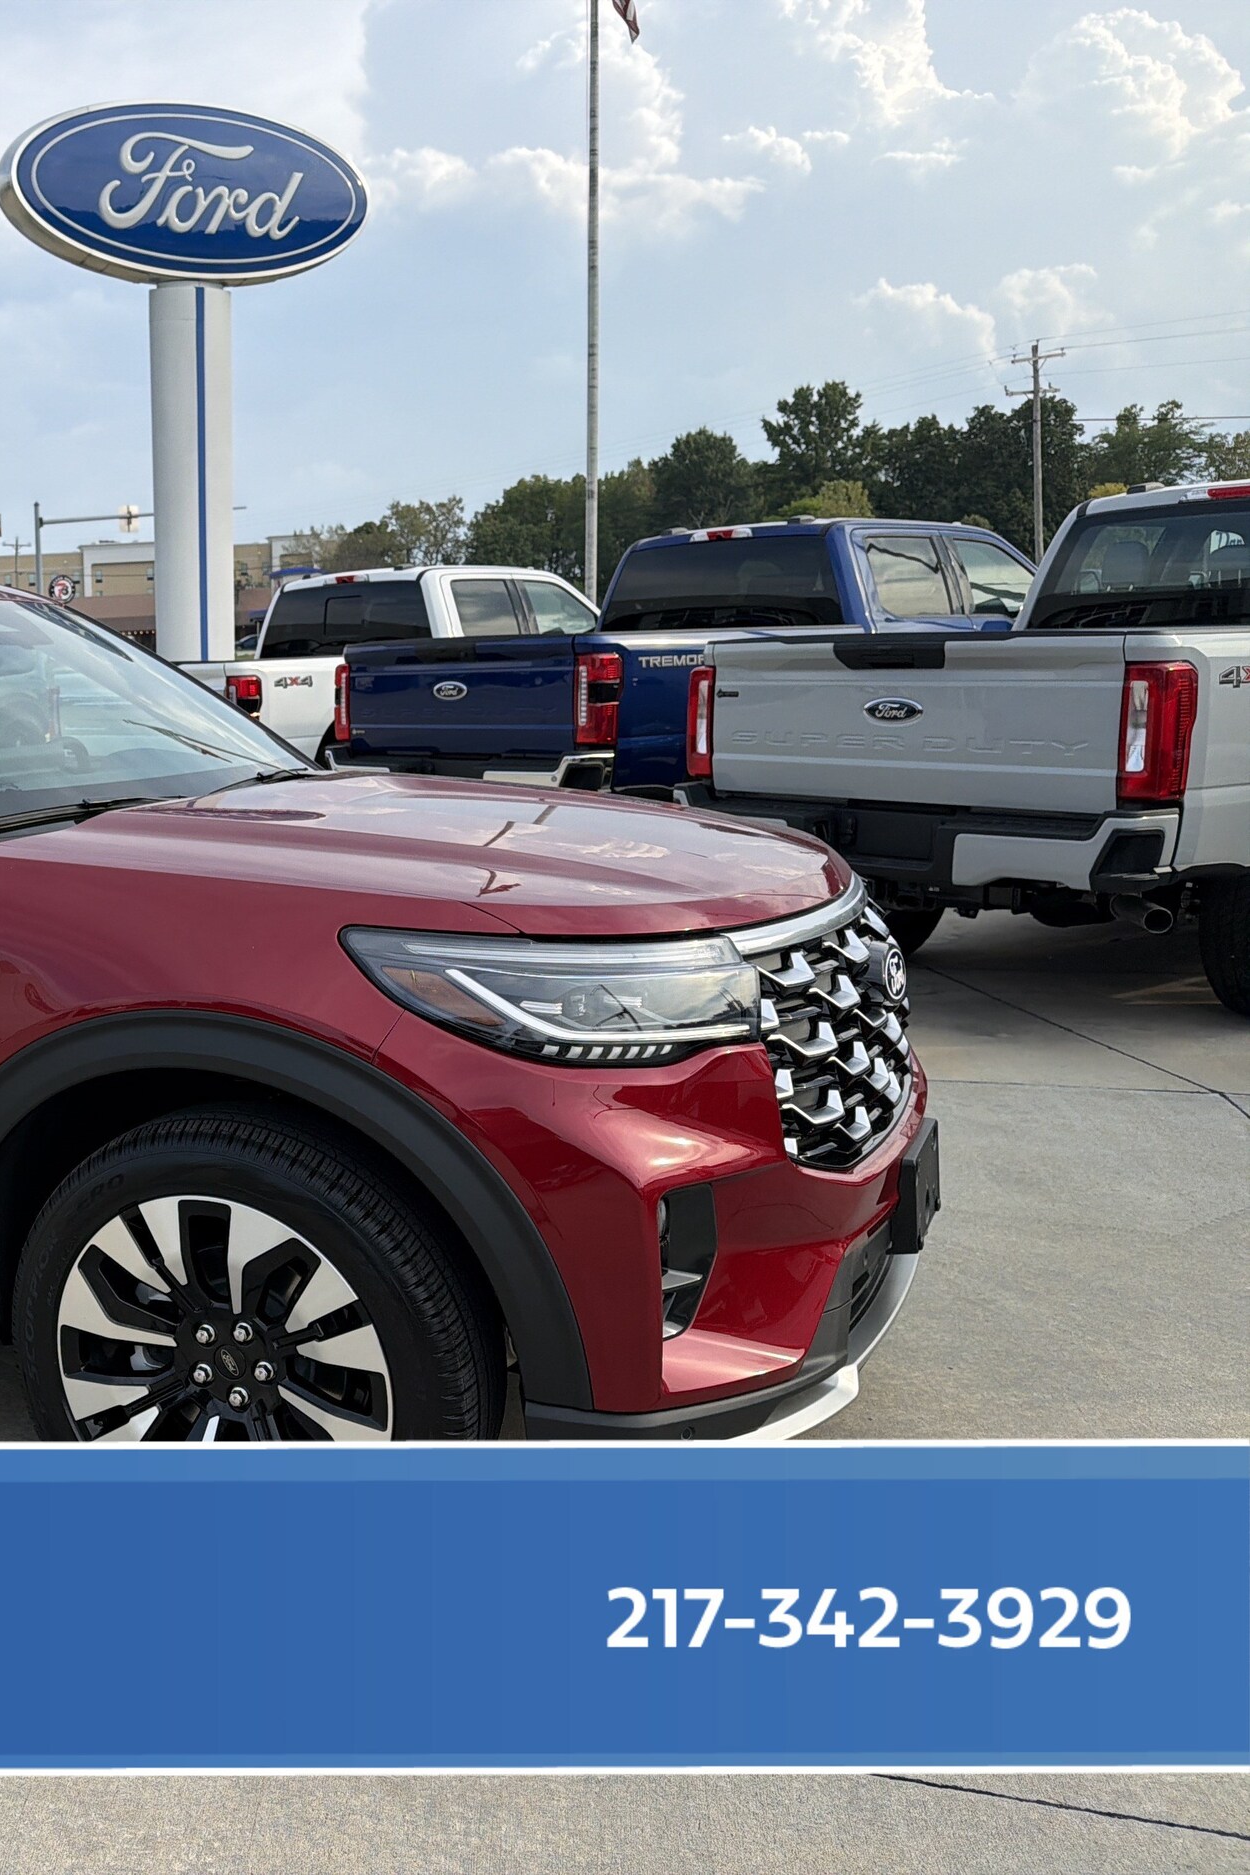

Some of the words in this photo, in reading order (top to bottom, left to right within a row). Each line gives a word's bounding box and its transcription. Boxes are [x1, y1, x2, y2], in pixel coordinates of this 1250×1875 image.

[98, 131, 304, 241] Ford
[875, 702, 908, 719] Ford
[732, 730, 905, 751] SUPER
[923, 736, 1089, 756] DUTY
